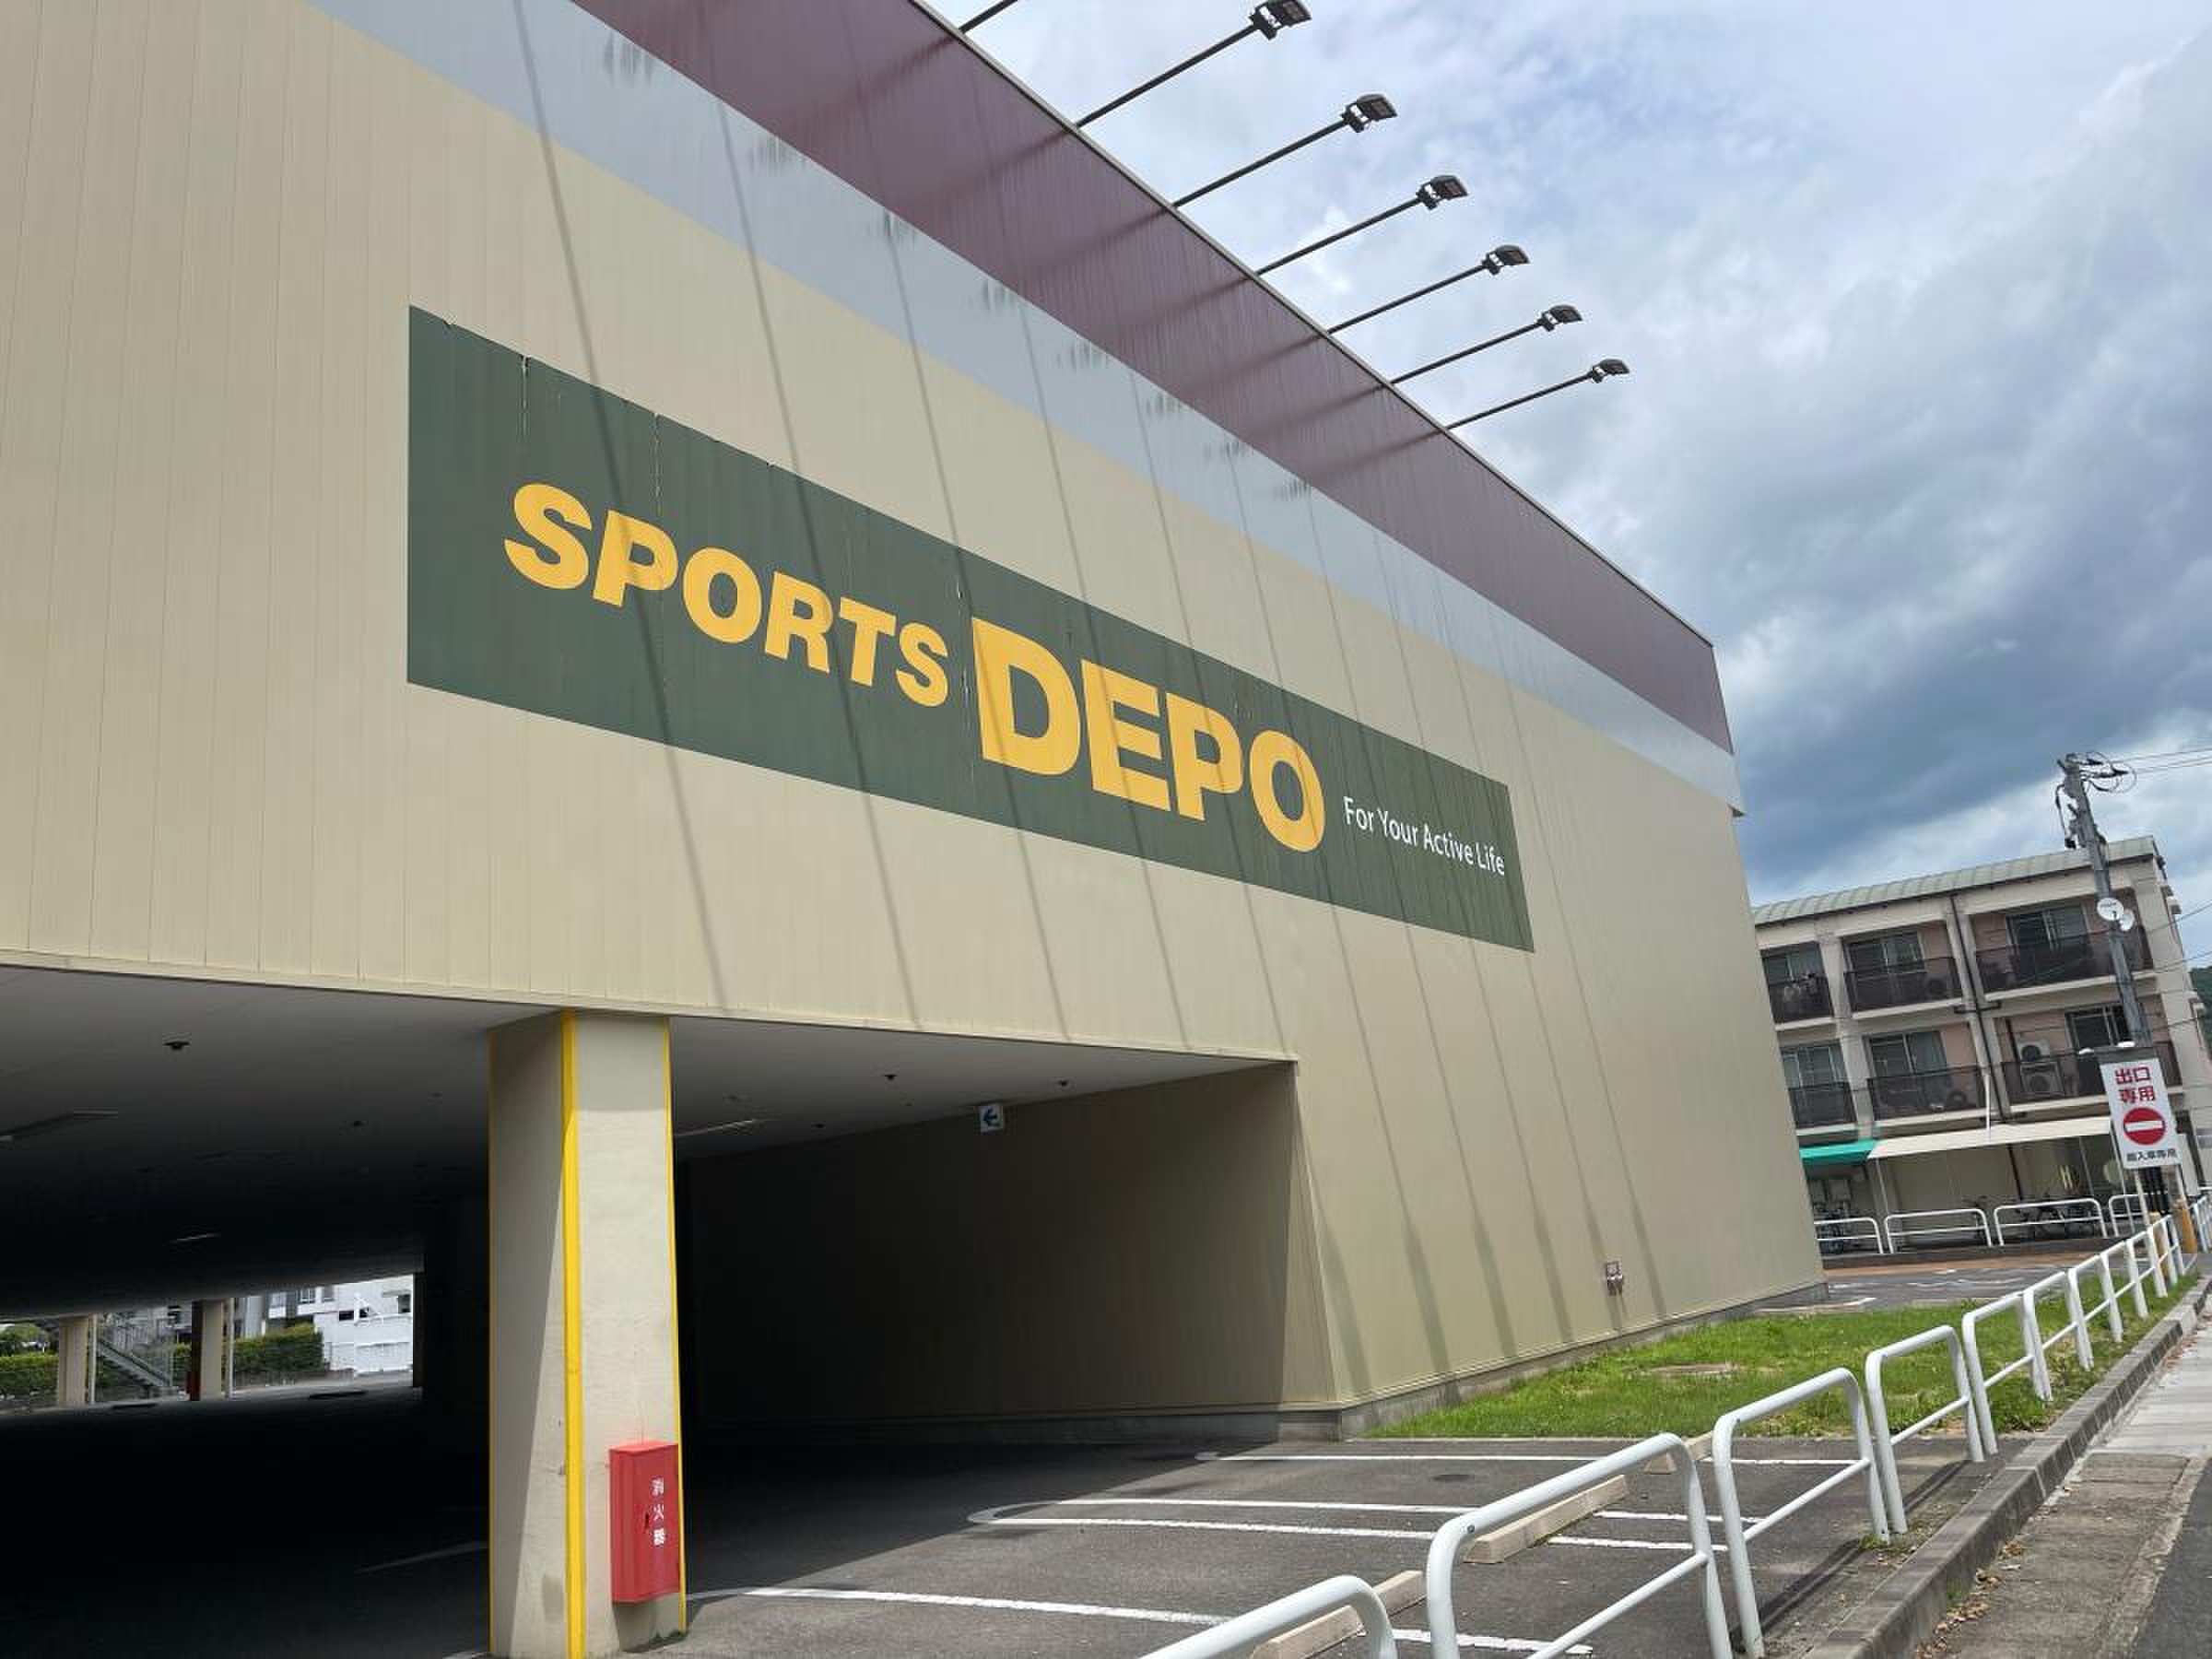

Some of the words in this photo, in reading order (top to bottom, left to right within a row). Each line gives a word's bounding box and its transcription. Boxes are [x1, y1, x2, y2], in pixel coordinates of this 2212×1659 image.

[504, 483, 948, 707] SPORTS
[972, 618, 1325, 853] DEPO
[1343, 795, 1373, 832] For
[1378, 807, 1418, 847] Your
[1423, 823, 1474, 865] Active
[1476, 842, 1505, 876] Life
[2115, 1066, 2151, 1084] 出口
[2118, 1086, 2156, 1103] 専用
[651, 1476, 665, 1546] 消火器
